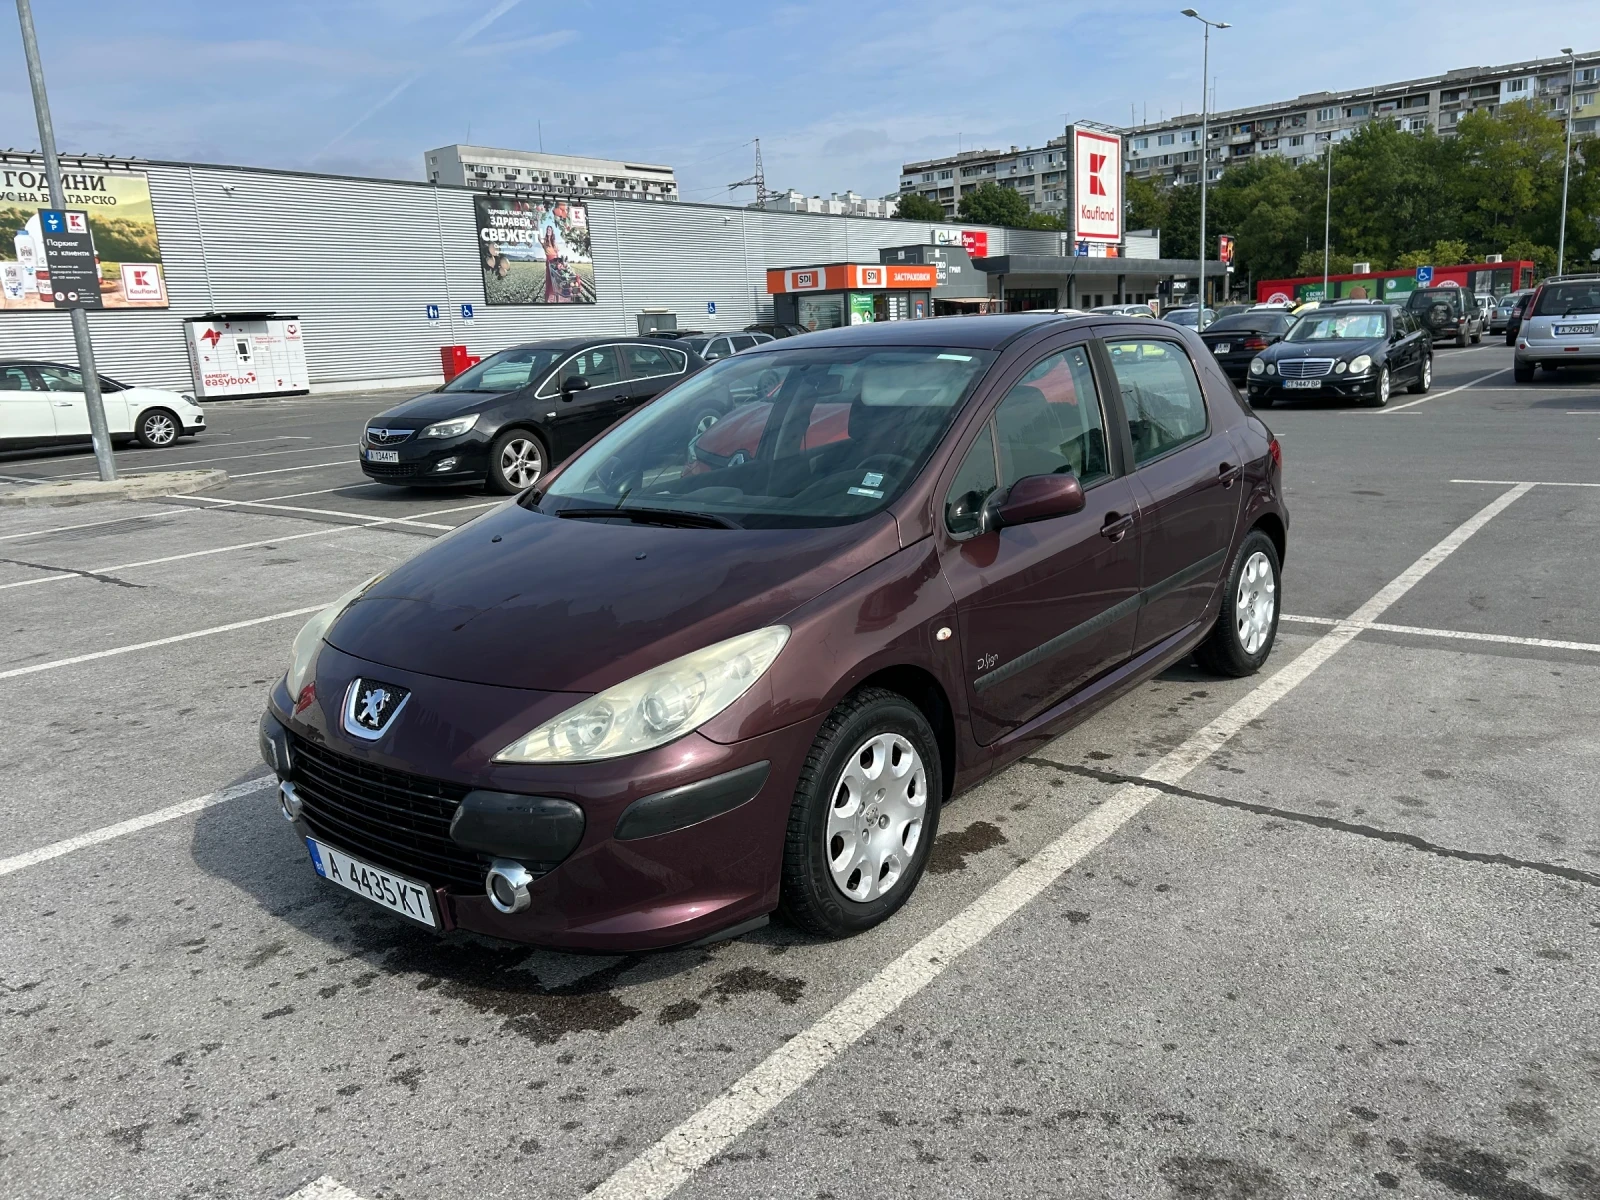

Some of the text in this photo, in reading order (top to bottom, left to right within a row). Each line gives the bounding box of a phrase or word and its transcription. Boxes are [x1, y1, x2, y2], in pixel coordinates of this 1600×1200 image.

[18, 193, 38, 202] НА
[1081, 204, 1115, 222] Kaufland
[490, 216, 533, 228] ЗДРАВЕЙ,
[481, 227, 544, 243] СВЕЖЕСТ!
[46, 238, 79, 248] Паркинг
[799, 274, 811, 284] SDI
[867, 272, 876, 280] SDI
[893, 273, 930, 281] ЗАСТРАХОВКИ
[205, 376, 250, 387] easybox
[328, 852, 343, 882] A
